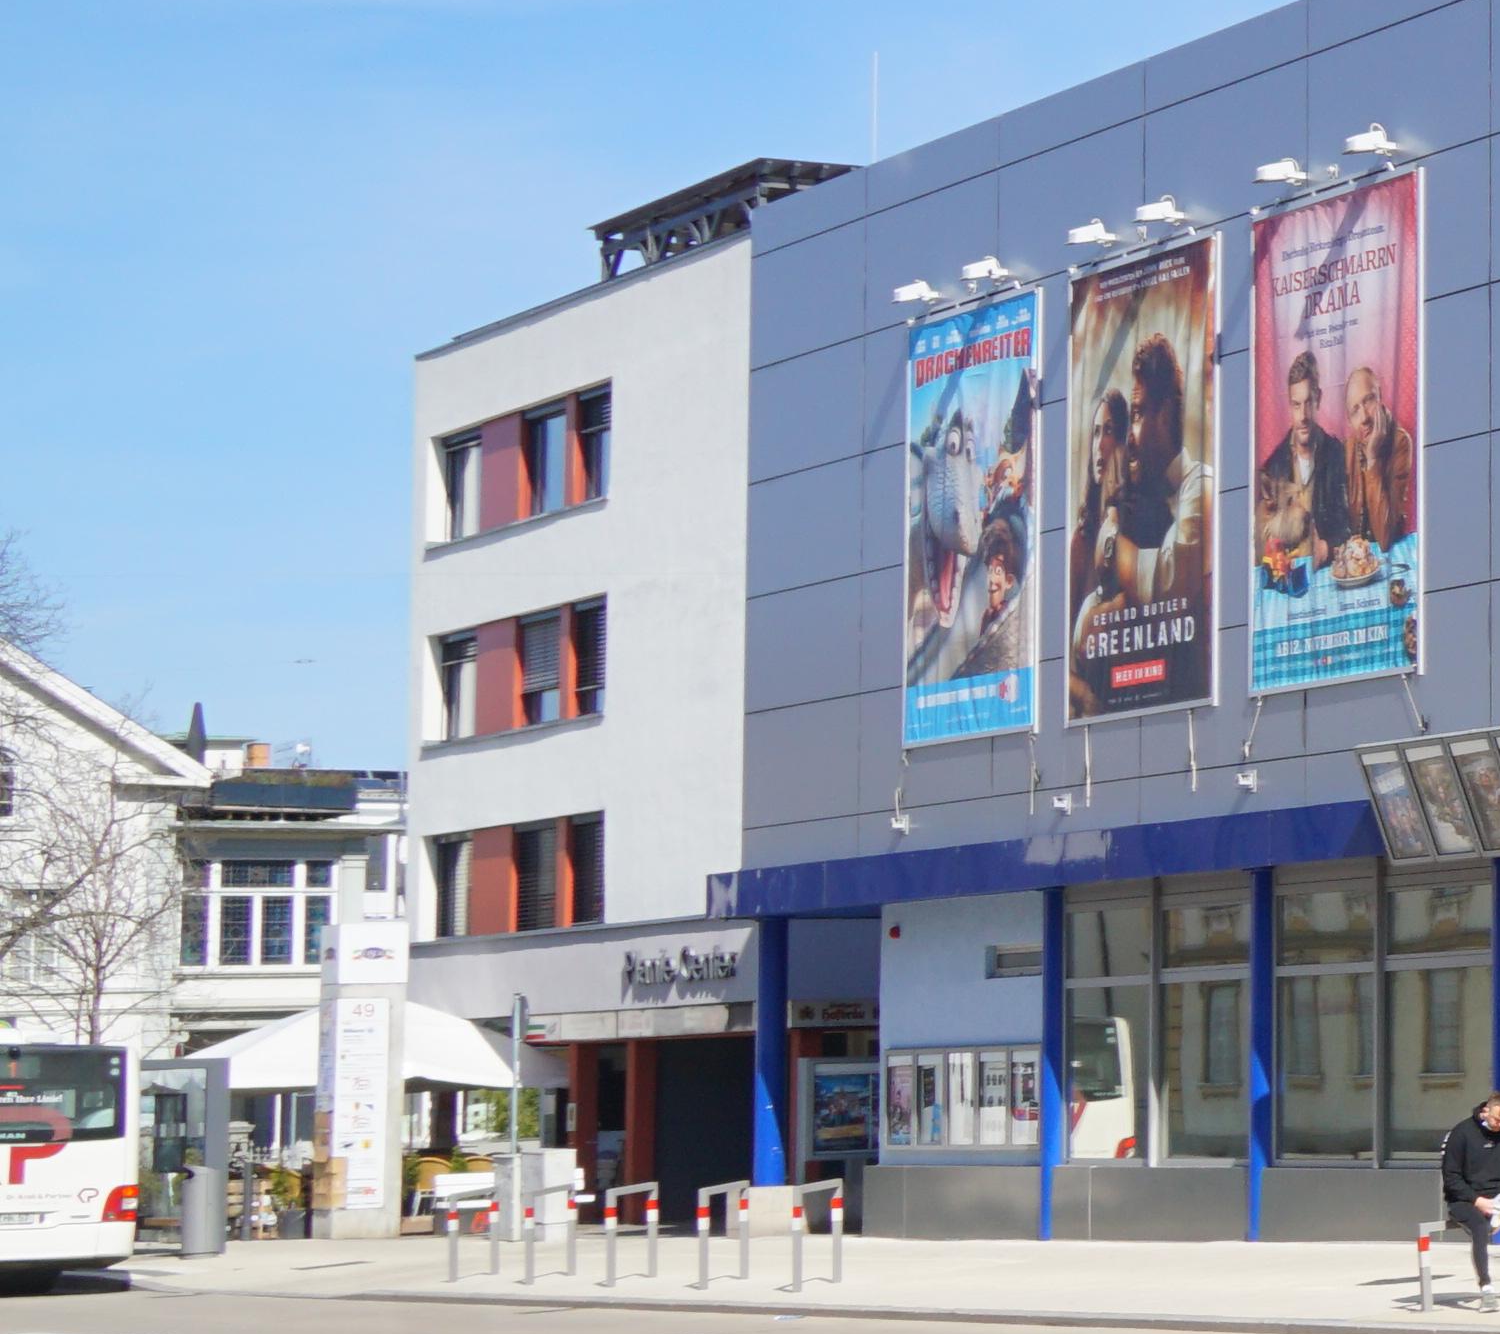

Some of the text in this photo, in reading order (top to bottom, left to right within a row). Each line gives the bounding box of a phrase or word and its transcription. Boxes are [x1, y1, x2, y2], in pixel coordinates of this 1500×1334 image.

[1272, 243, 1397, 297] KAISERSCHMARRN
[1305, 280, 1361, 319] DRAMA
[915, 327, 1031, 389] DRACHENREITER
[1143, 597, 1188, 617] BUTLER
[1086, 616, 1195, 660] GREENLAND
[352, 1003, 375, 1018] 49
